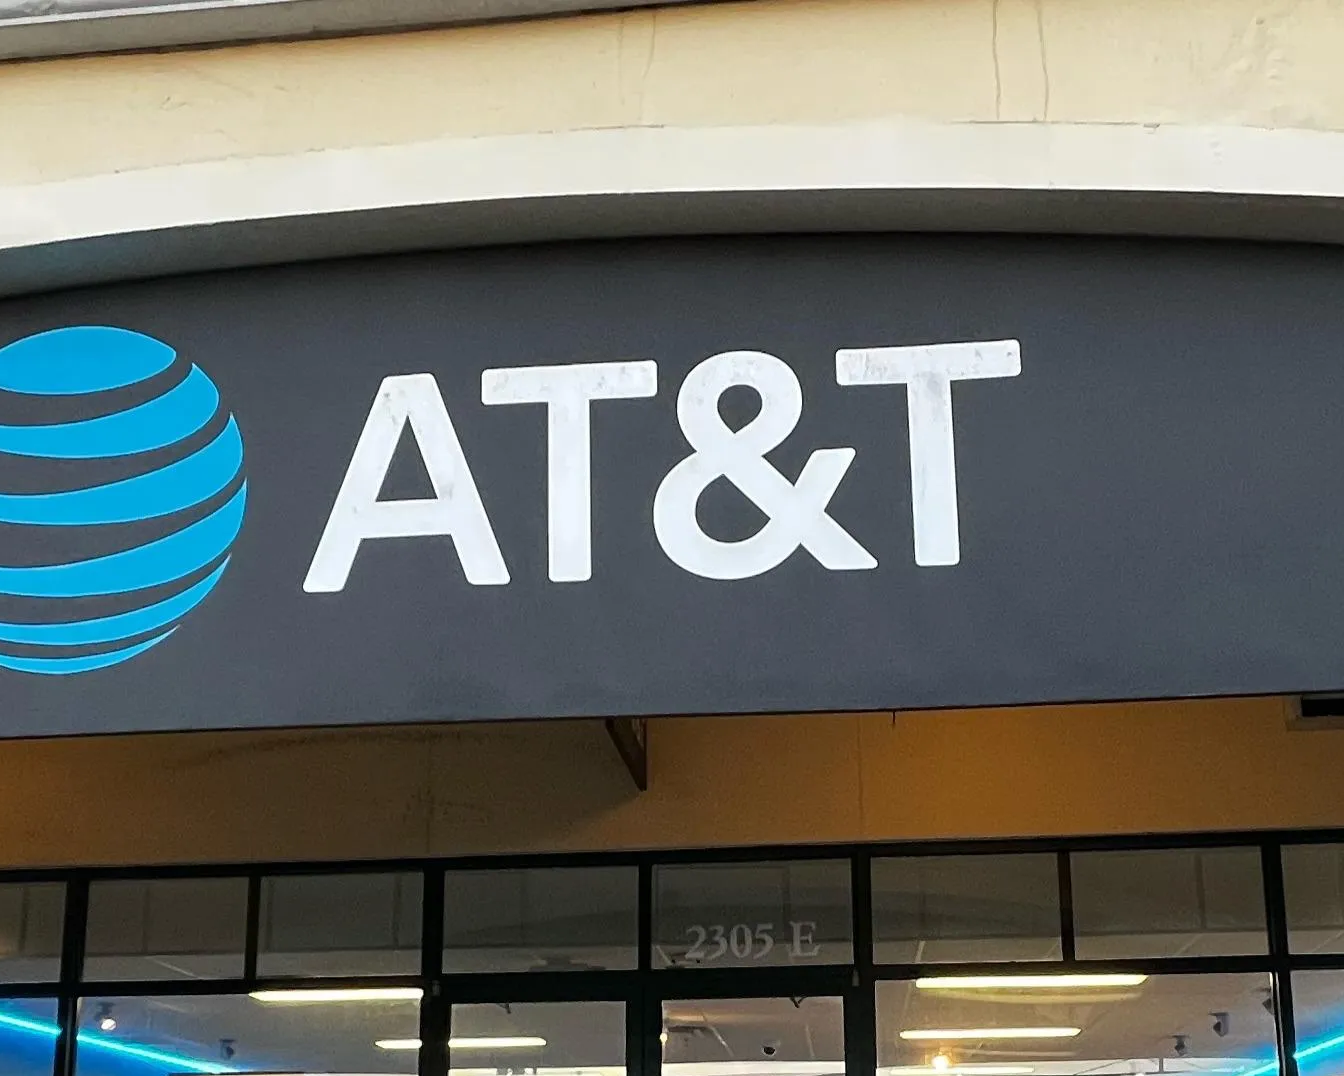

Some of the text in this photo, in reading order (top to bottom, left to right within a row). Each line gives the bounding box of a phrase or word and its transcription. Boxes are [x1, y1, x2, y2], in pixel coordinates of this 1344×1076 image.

[303, 338, 1021, 593] AT&T
[684, 921, 821, 960] 2305 E
